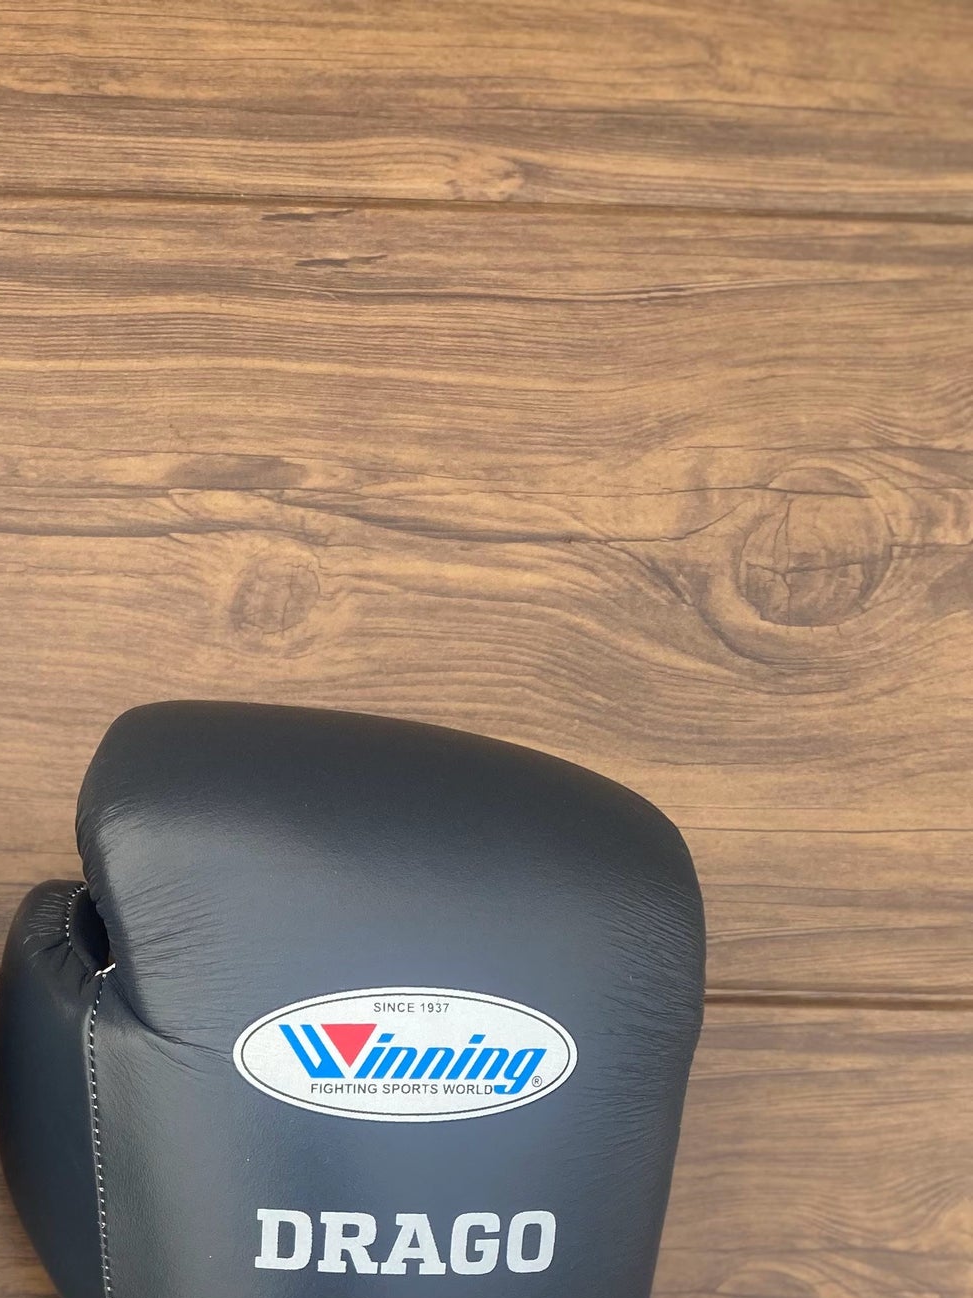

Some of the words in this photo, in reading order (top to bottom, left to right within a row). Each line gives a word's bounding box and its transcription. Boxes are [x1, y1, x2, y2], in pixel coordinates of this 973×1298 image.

[373, 1002, 415, 1013] SINCE
[420, 1002, 449, 1013] 1937
[278, 1023, 547, 1095] Winning
[310, 1083, 378, 1095] FIGHTING
[382, 1083, 439, 1095] SPORTS
[443, 1083, 494, 1095] WORLD
[254, 1208, 557, 1275] DRAGO
